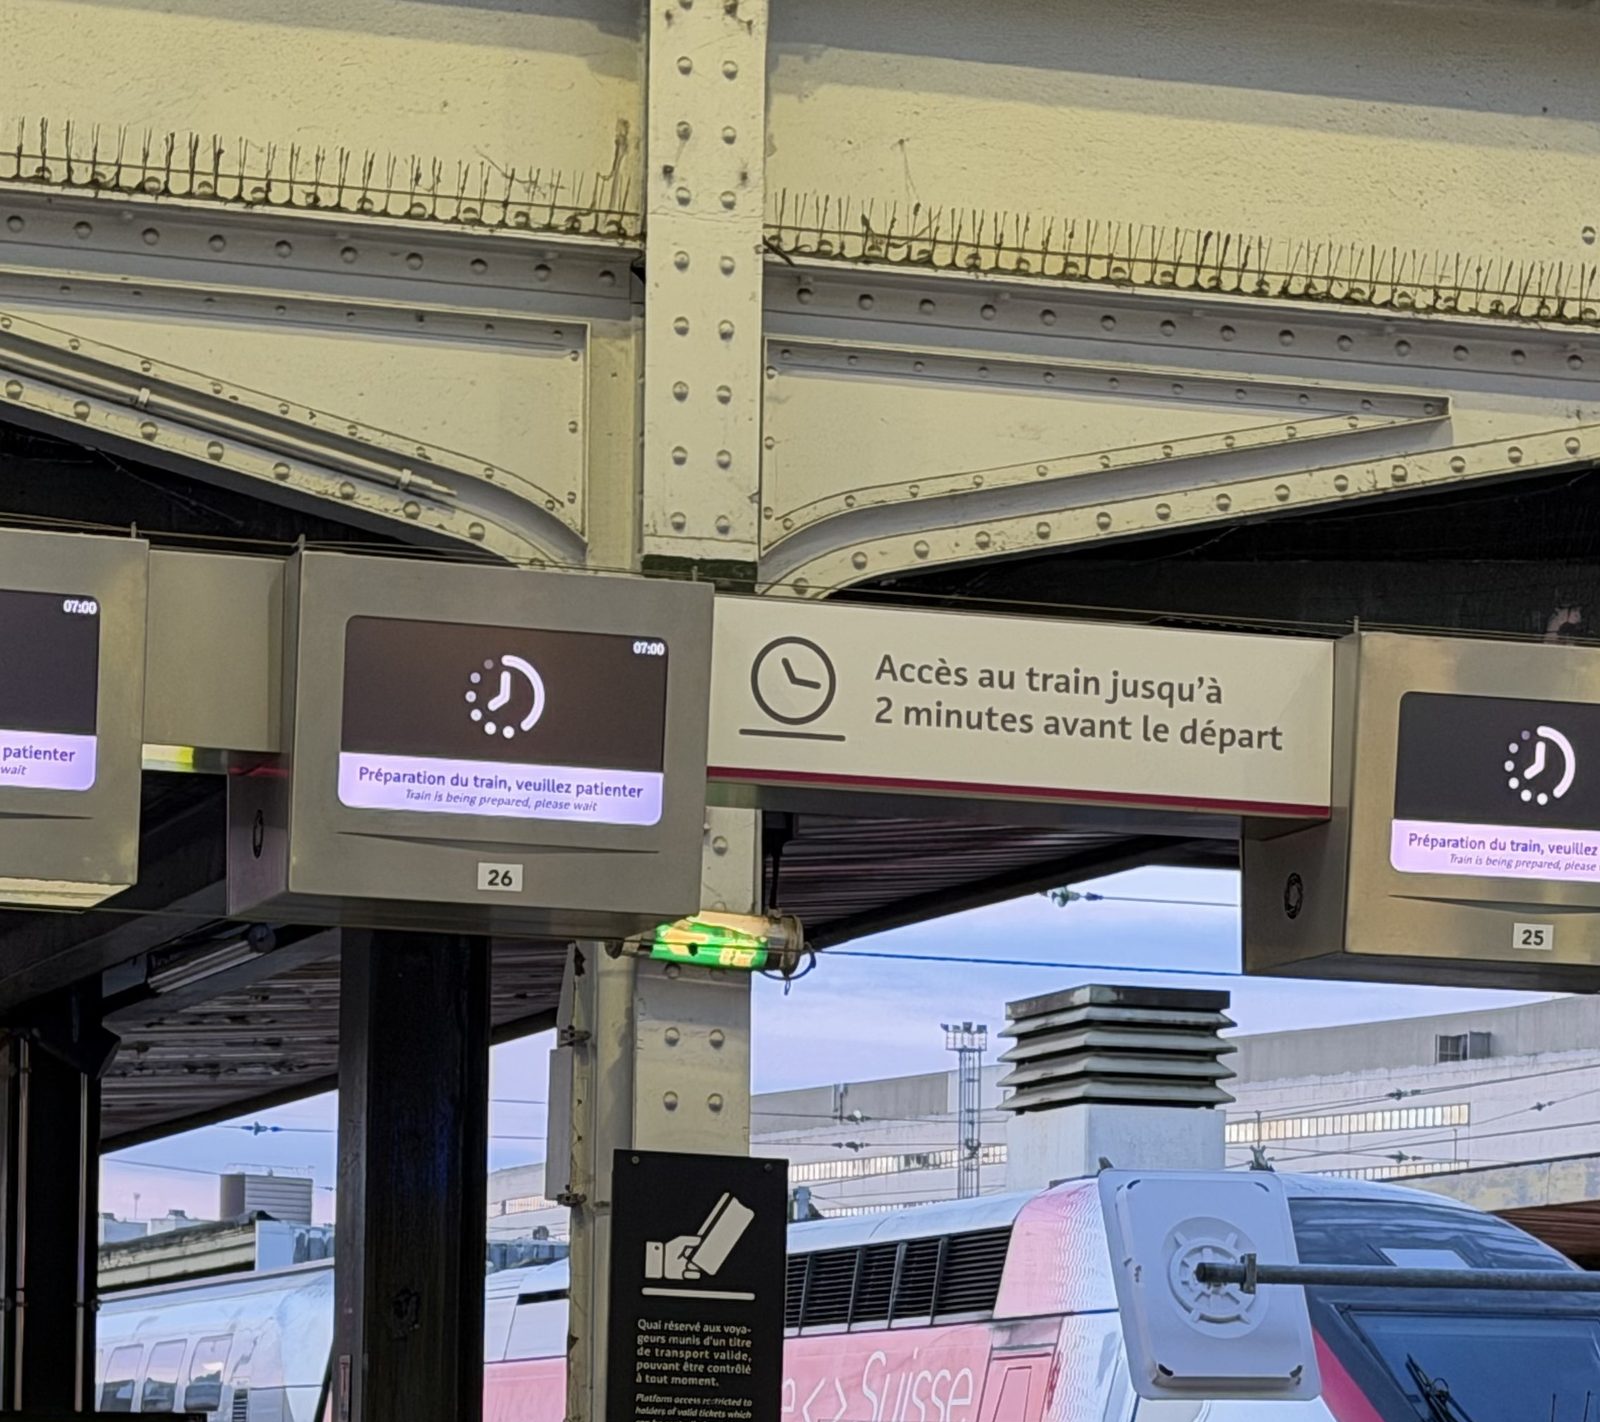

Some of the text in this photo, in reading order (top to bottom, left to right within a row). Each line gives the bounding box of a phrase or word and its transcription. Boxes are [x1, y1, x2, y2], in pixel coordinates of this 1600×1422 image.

[63, 600, 97, 614] 07:00
[633, 641, 665, 656] 07:00
[875, 654, 968, 687] Accès
[978, 668, 1015, 689] au
[1026, 667, 1100, 696] train
[875, 697, 1283, 754] 2 minutes avant le départ
[3, 746, 75, 762] patienter
[1, 765, 27, 776] wait
[359, 766, 643, 799] Préparation du train, veuillez patienter
[406, 789, 597, 812] Train is being prepared, please wait
[1409, 832, 1598, 856] Préparation du train, veuillez
[1450, 854, 1596, 872] Train is being prepared, please
[487, 869, 513, 887] 26
[1522, 929, 1544, 945] 25
[638, 1319, 751, 1336] Quai réservé aux voya-
[637, 1335, 666, 1345] geurs
[668, 1335, 700, 1345] munis
[728, 1337, 752, 1348] titre
[637, 1346, 752, 1363] de transport valide,
[636, 1361, 752, 1375] pouvant être contrôlé
[636, 1373, 720, 1387] à tout moment.
[635, 1393, 672, 1404] Platform
[743, 1399, 752, 1407] to
[667, 1406, 678, 1416] of
[677, 1408, 698, 1417] valid
[699, 1409, 726, 1418] tickets
[727, 1411, 752, 1419] which
